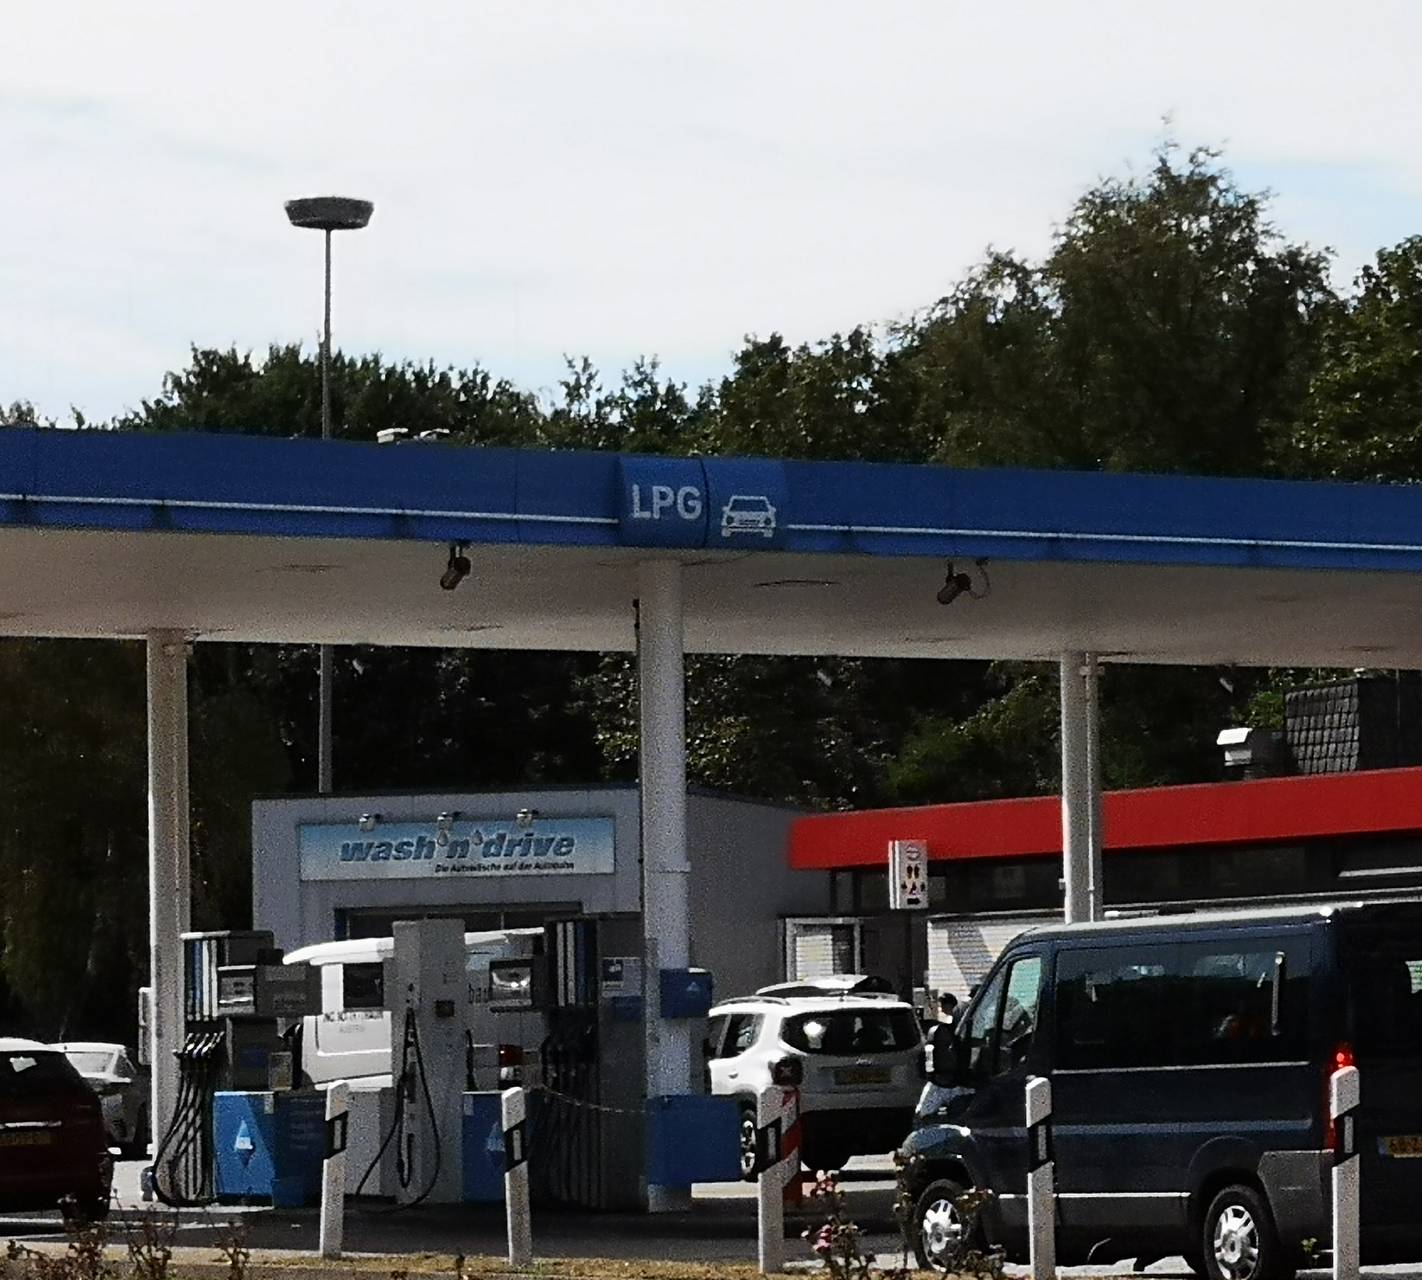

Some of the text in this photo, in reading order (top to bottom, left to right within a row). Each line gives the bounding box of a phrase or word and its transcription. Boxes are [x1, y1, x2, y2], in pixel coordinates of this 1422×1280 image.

[632, 484, 702, 519] LPG
[435, 864, 449, 873] Die
[518, 861, 533, 871] der
